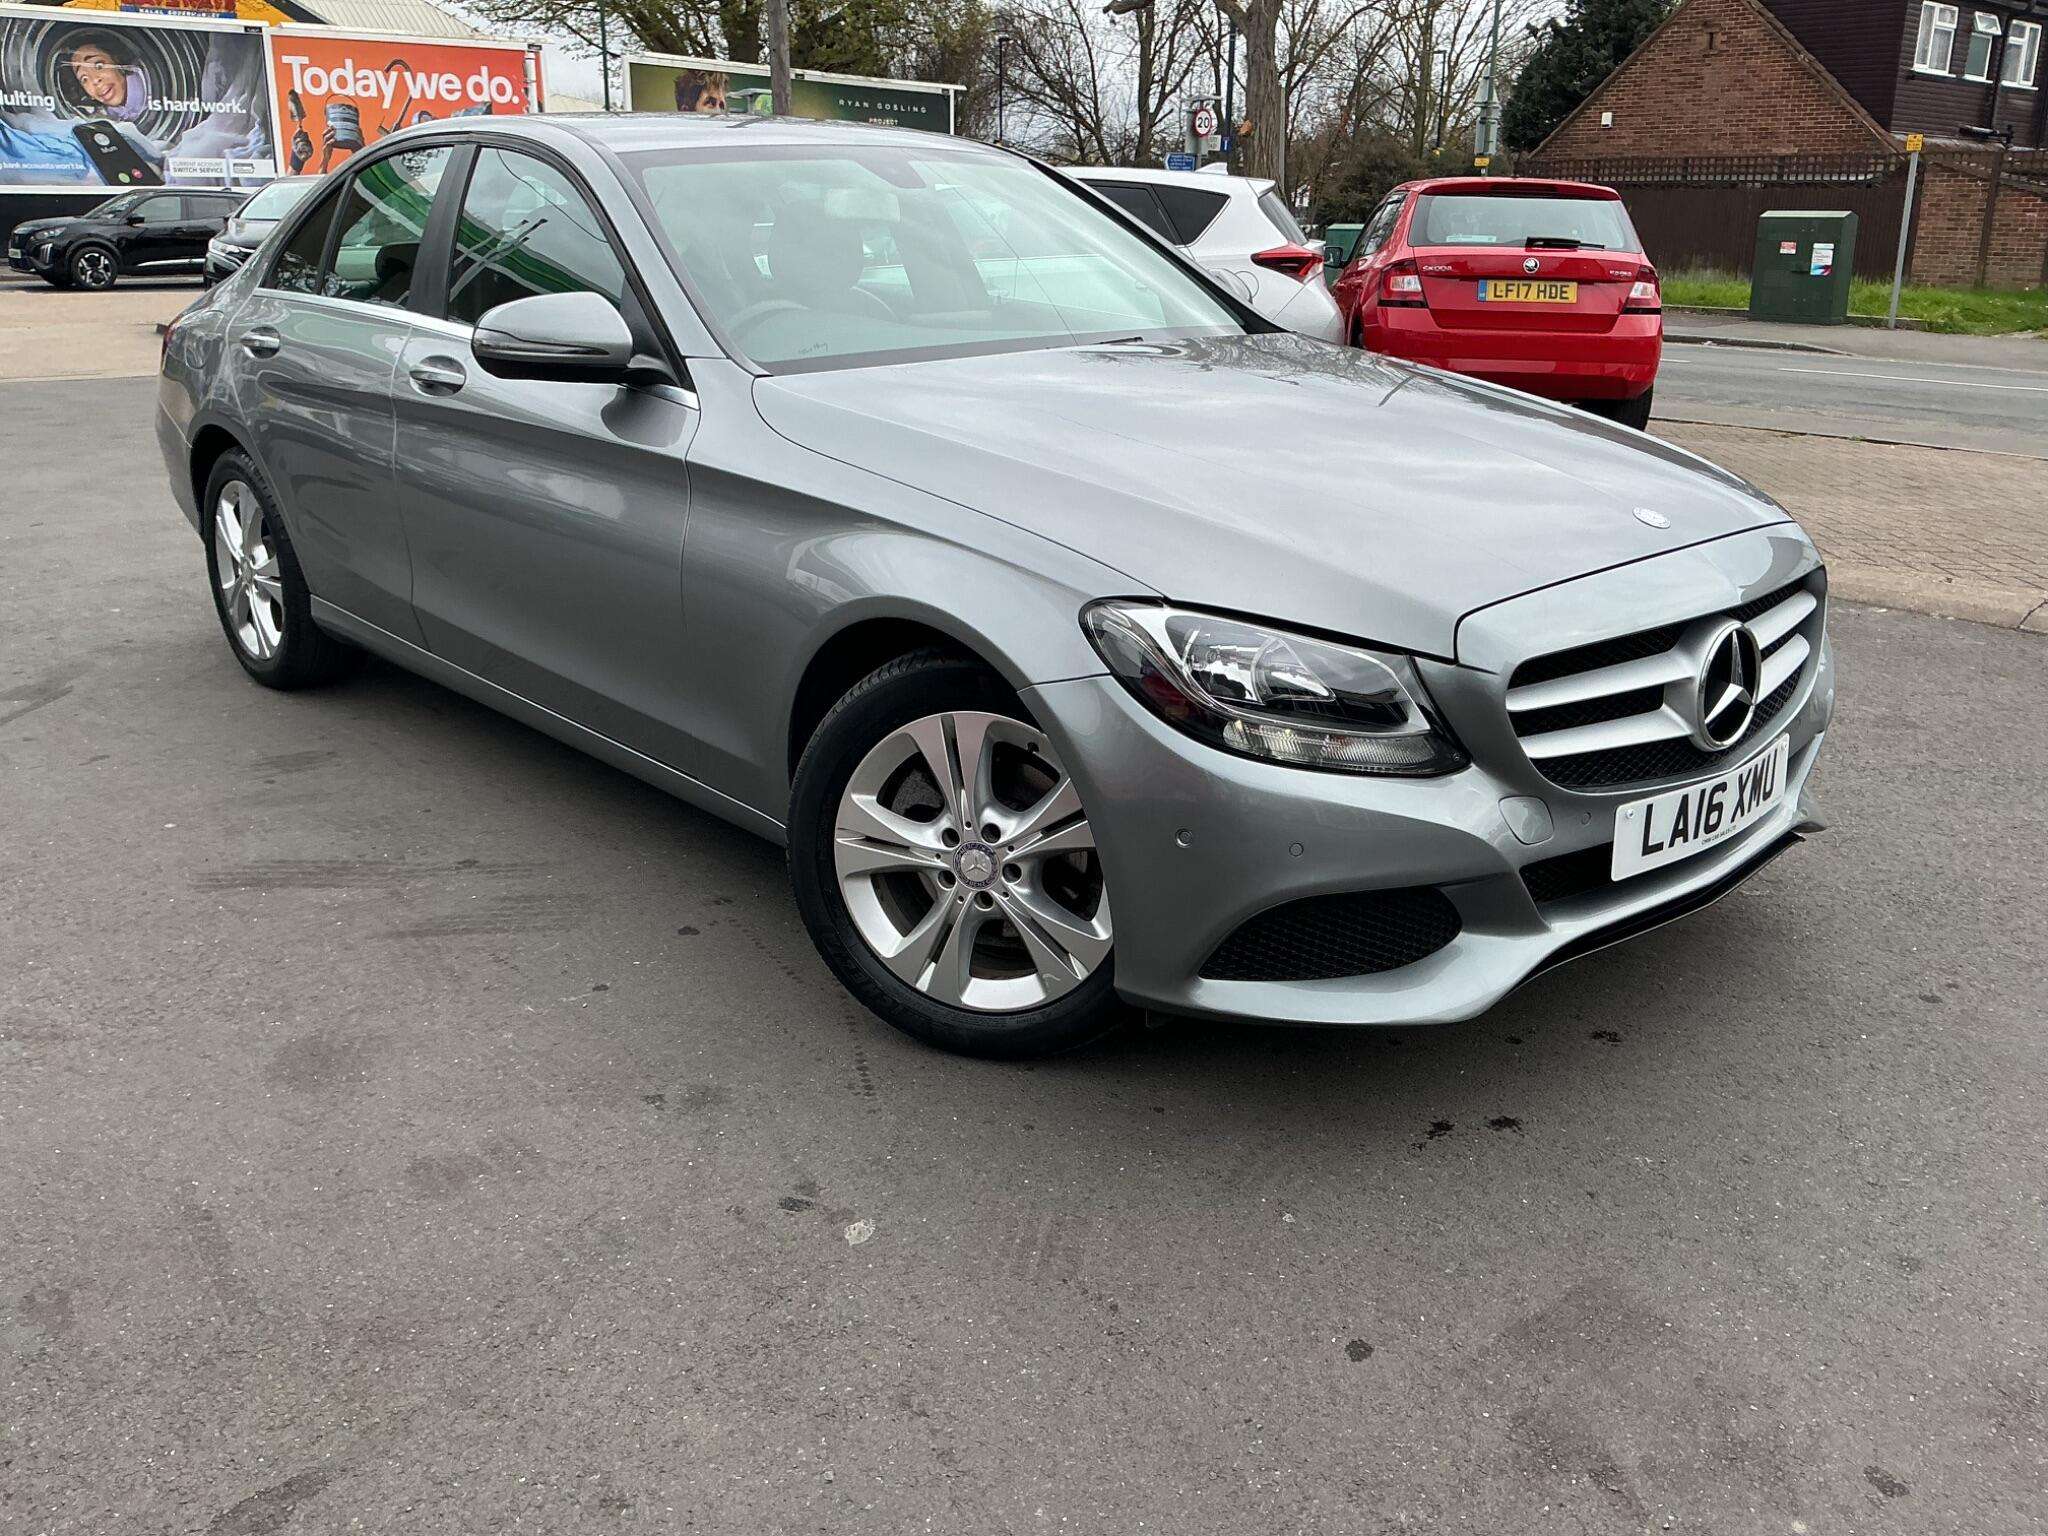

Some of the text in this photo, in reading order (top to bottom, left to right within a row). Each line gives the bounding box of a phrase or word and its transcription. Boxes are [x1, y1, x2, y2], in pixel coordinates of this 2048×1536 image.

[281, 55, 520, 109] Today we do.
[147, 96, 161, 111] is
[163, 96, 200, 112] hard
[201, 99, 247, 114] work.
[839, 99, 927, 114] RYAN GOSLING
[868, 117, 899, 126] PROJECT
[1197, 116, 1210, 129] 20
[1493, 282, 1570, 300] LF17 HDE
[1641, 748, 1778, 857] LA16 XMU
